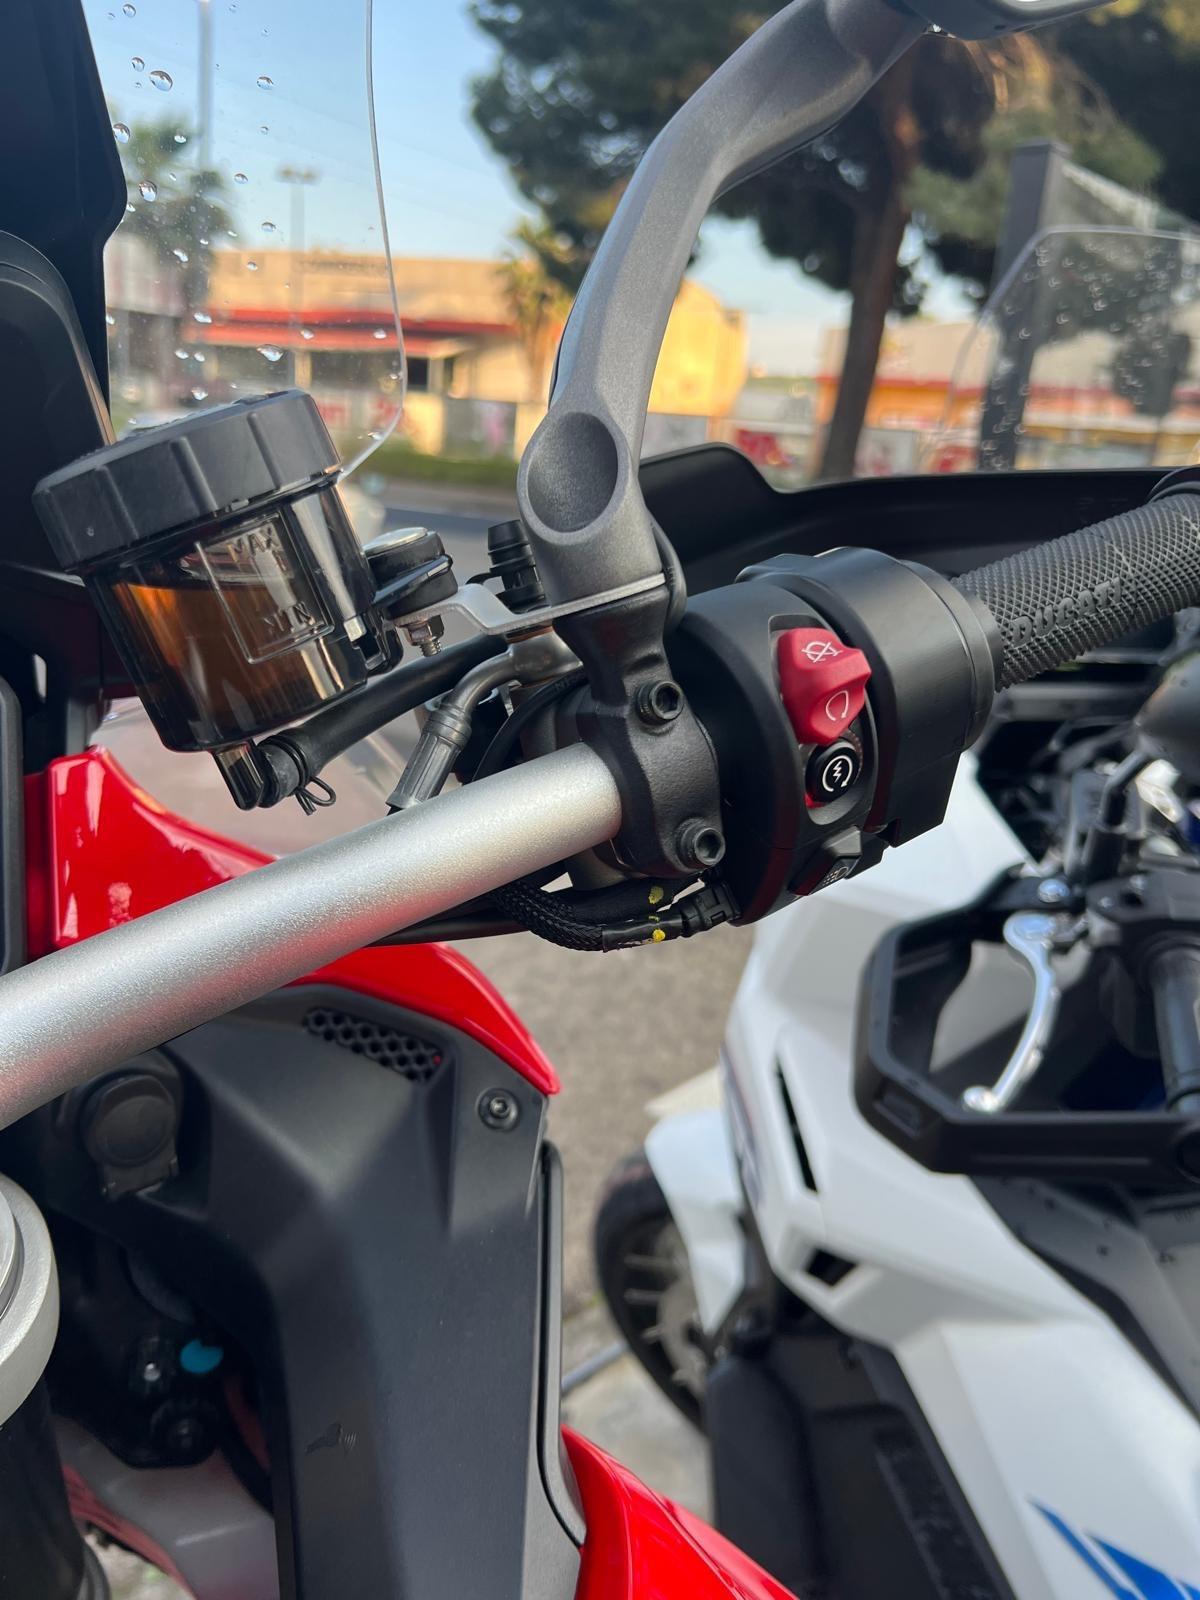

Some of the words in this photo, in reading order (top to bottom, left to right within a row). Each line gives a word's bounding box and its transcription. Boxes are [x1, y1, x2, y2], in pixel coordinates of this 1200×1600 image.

[226, 527, 281, 563] MAX
[263, 601, 315, 632] MIN
[1010, 577, 1121, 649] DUCATI
